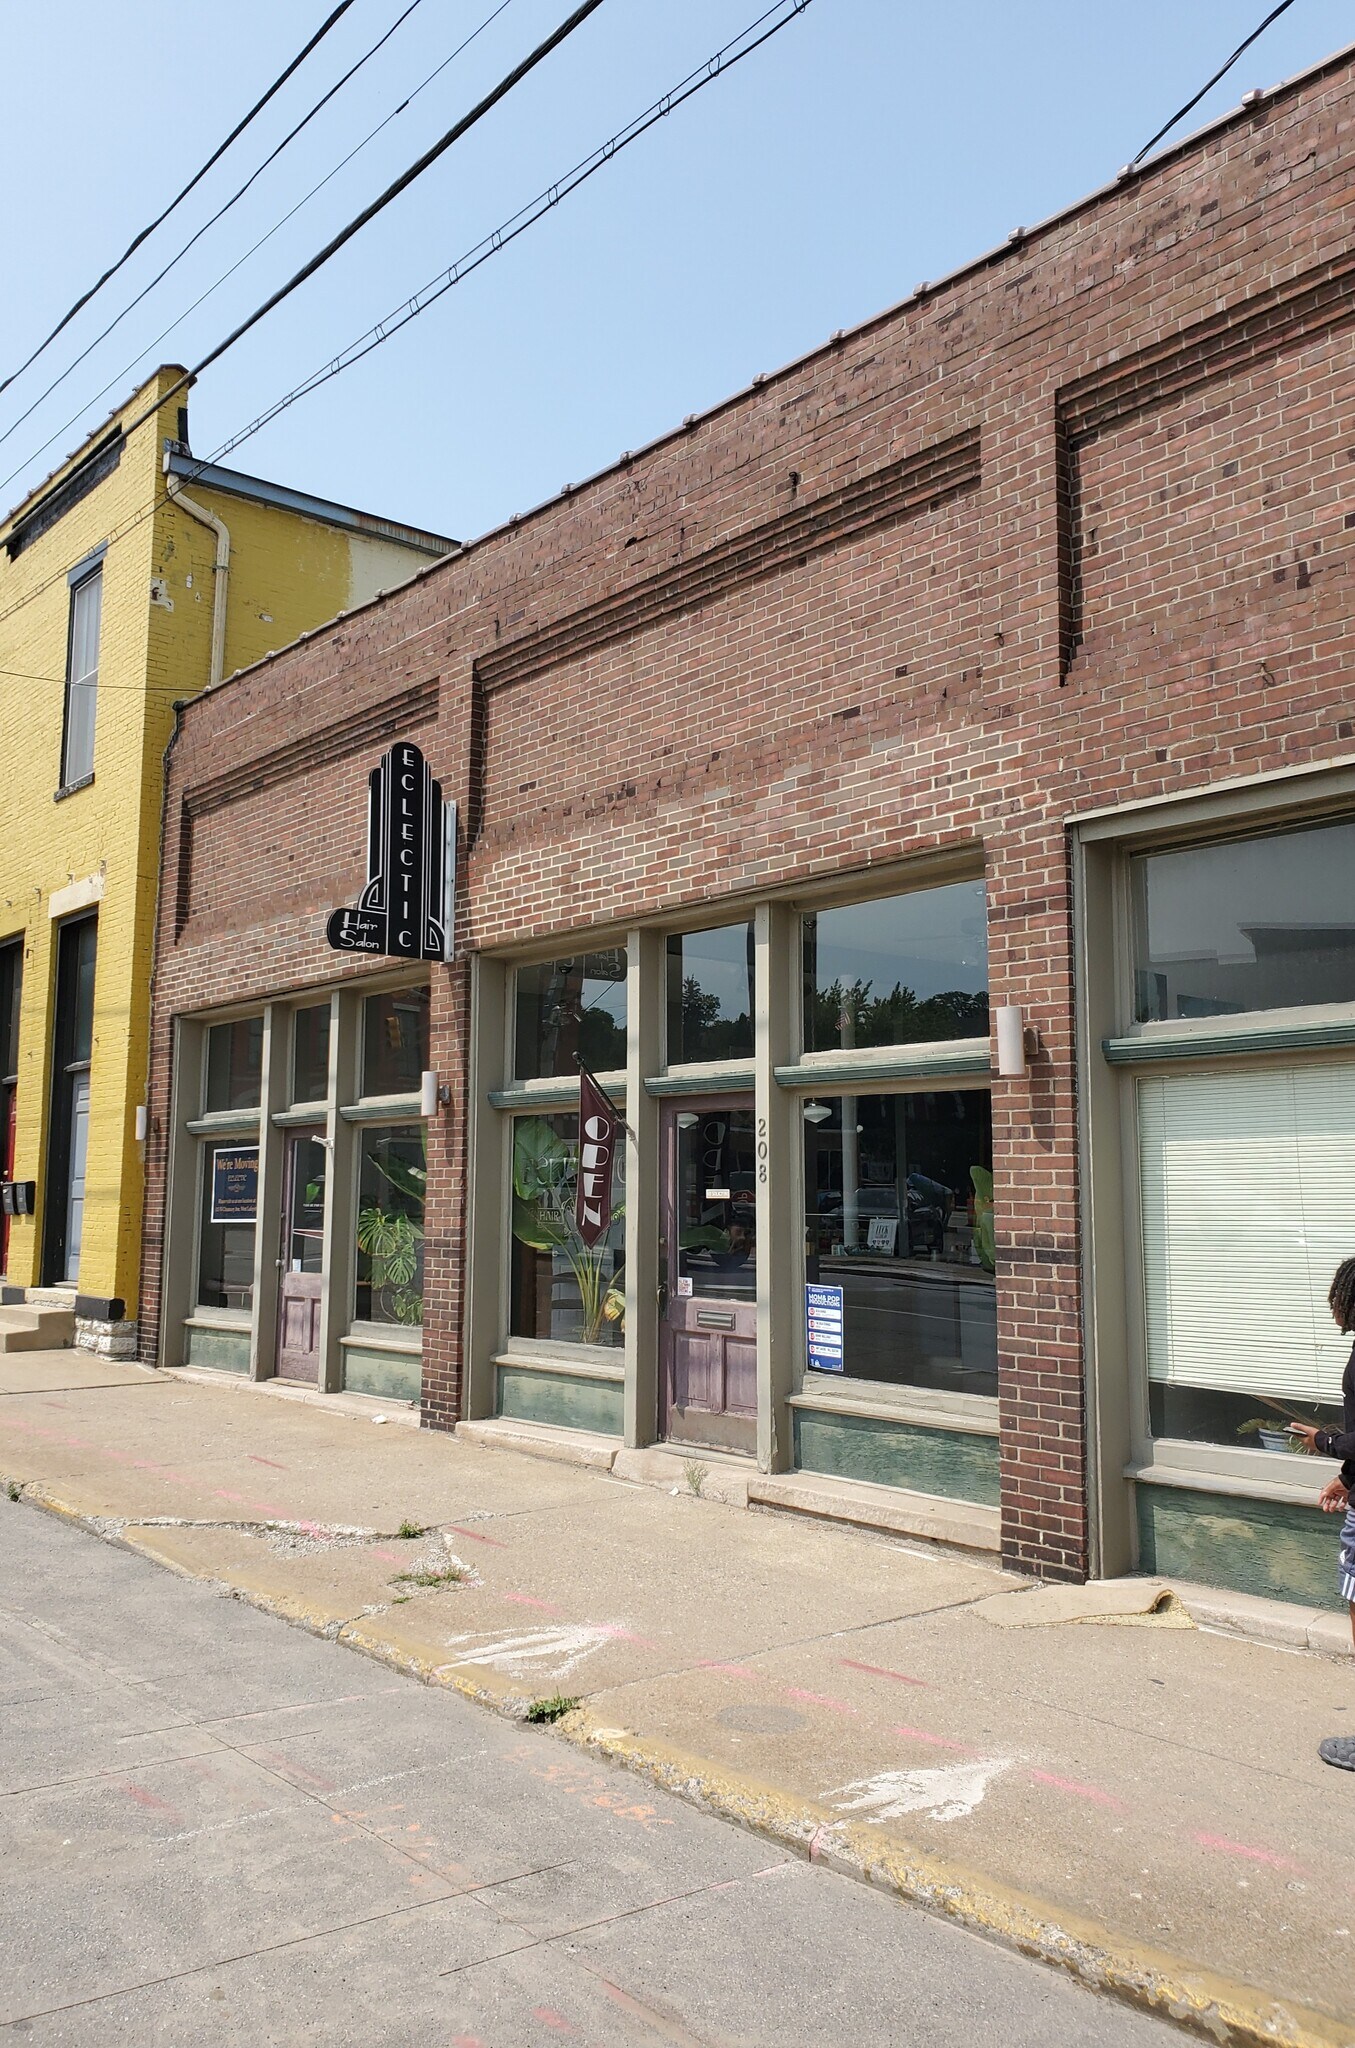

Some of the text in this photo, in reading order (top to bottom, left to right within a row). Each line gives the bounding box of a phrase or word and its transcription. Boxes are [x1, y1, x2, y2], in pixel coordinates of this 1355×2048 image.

[398, 748, 414, 948] ECLECTIC
[342, 911, 378, 930] Hair
[339, 930, 380, 950] Salon
[757, 1118, 768, 1184] 208
[217, 1157, 258, 1173] We're Moving
[581, 1115, 610, 1227] OPEN
[539, 1211, 561, 1222] HAIR
